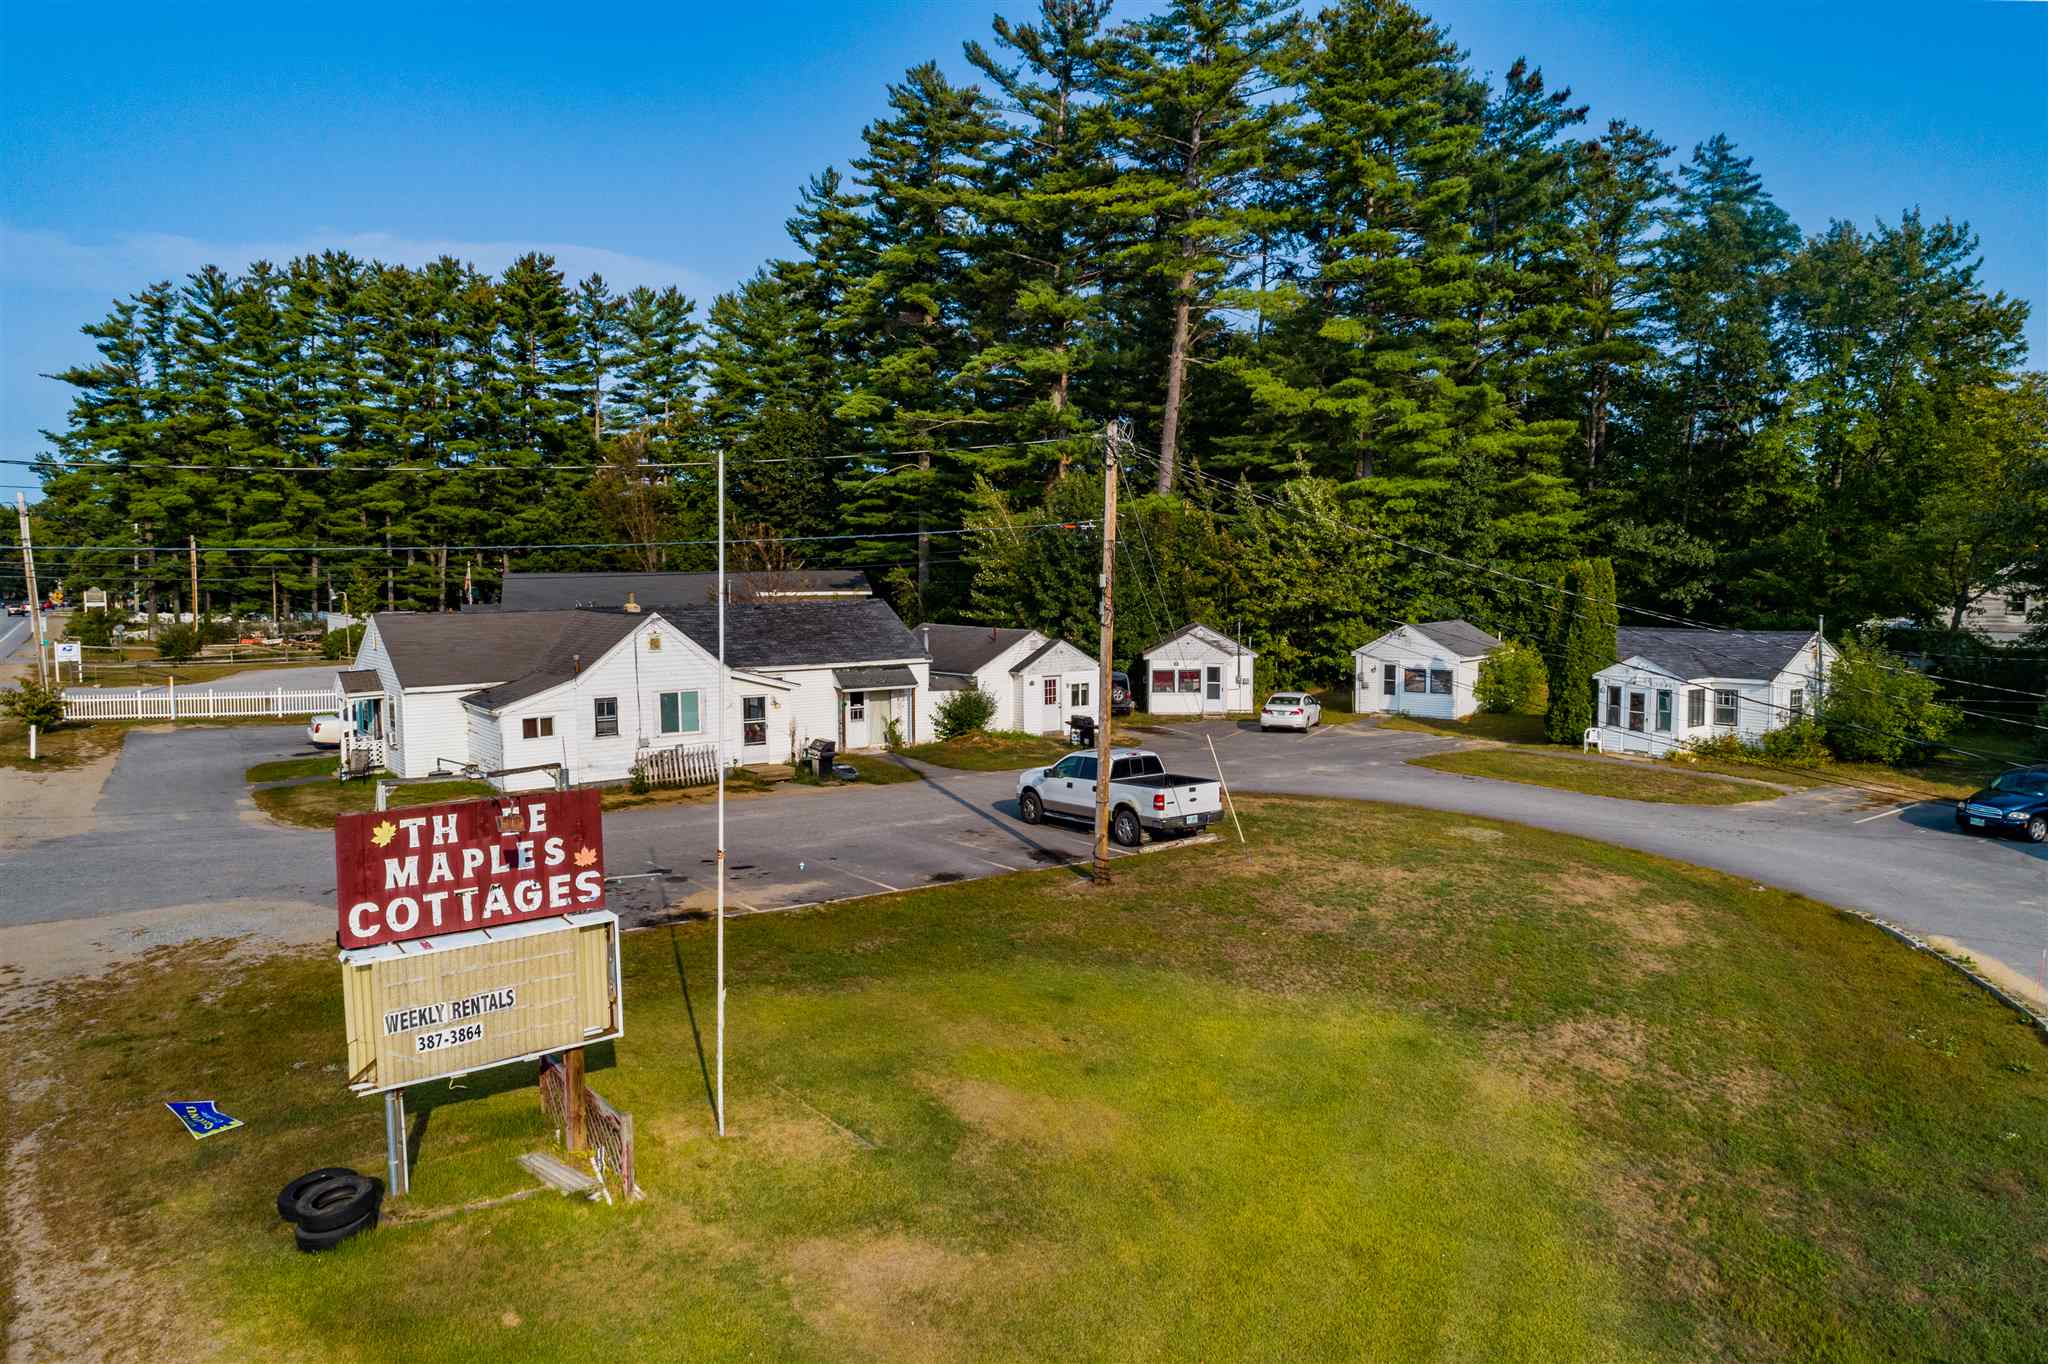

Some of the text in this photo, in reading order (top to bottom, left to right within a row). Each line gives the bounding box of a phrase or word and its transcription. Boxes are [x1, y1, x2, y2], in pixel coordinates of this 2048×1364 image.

[384, 837, 566, 889] MAPLES
[348, 870, 601, 938] COTTAGES
[384, 989, 515, 1034] WEEKLY RENTALS
[418, 1024, 482, 1051] 387-3864
